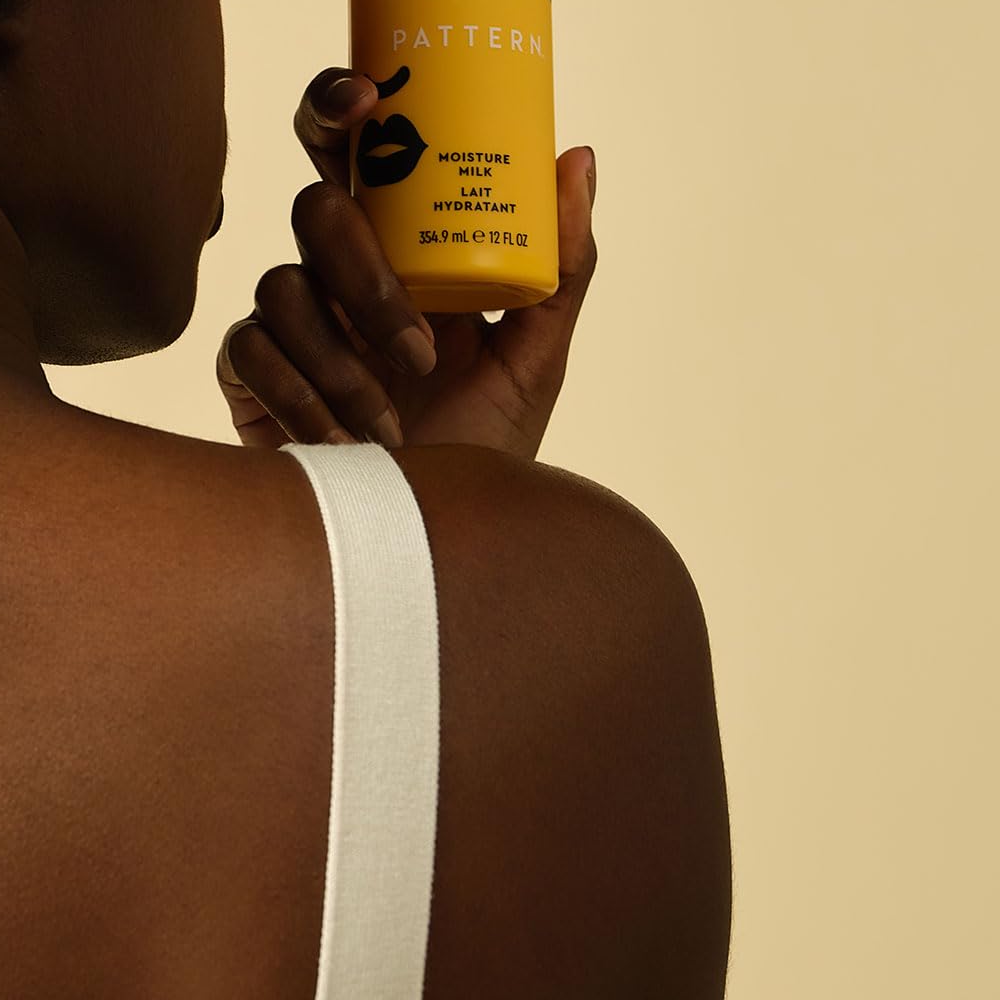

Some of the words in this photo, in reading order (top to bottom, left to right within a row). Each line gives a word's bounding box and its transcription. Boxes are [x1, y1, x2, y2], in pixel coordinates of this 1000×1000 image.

[392, 24, 542, 57] PATTERN
[438, 152, 511, 165] MOISTURE
[458, 166, 493, 177] MILK
[460, 187, 492, 197] LAIT
[433, 201, 517, 214] HYDRATANT
[418, 229, 449, 245] 354.9
[451, 229, 470, 243] mL
[488, 230, 501, 244] 12
[503, 231, 515, 246] FL
[516, 232, 529, 248] OZ
